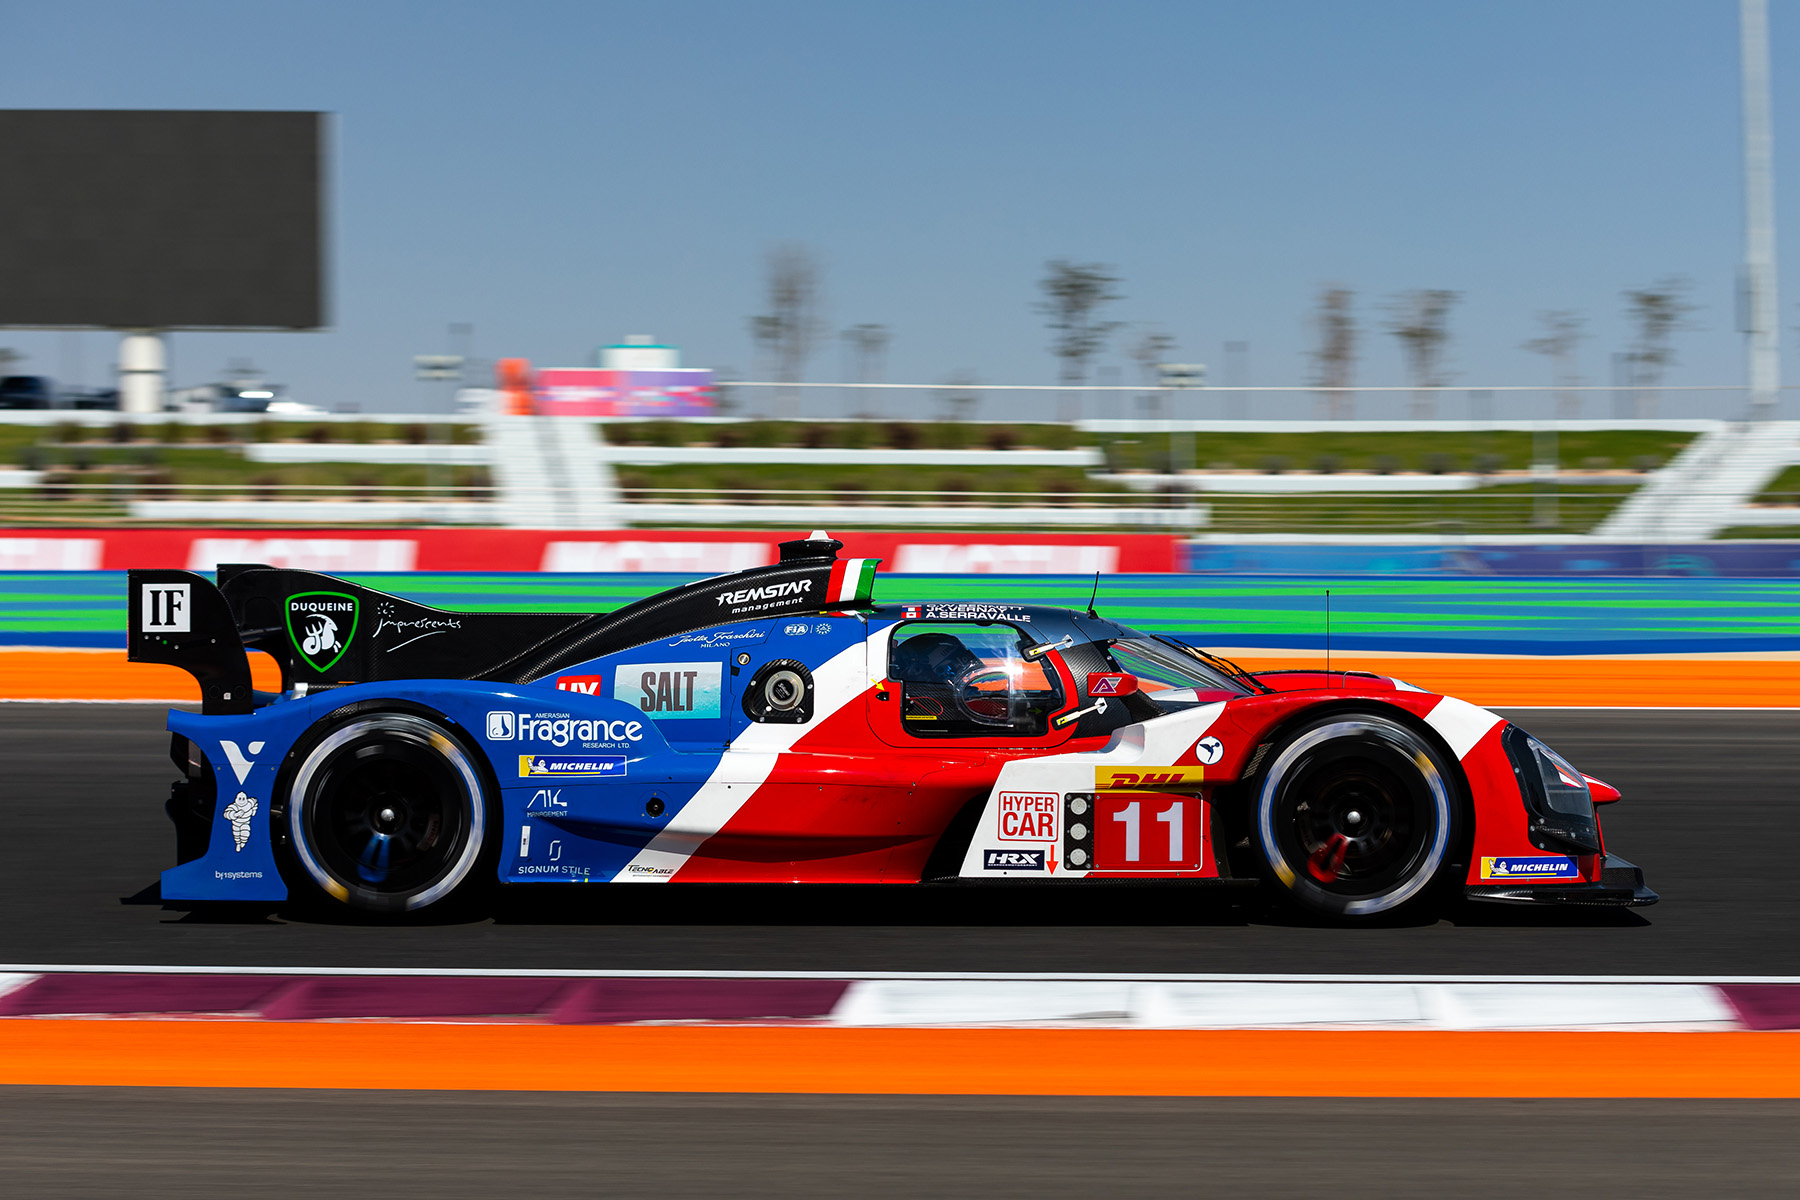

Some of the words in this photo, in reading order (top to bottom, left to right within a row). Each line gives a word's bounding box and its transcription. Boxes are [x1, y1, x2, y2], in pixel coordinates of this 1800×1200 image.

[716, 579, 812, 606] REMSTAR
[149, 590, 184, 626] IF
[291, 602, 353, 612] DUQUEINE
[731, 597, 803, 614] management
[925, 611, 1031, 622] A.SERRAVALLE
[785, 624, 807, 635] FIA
[640, 671, 697, 712] SALT
[518, 713, 643, 747] Fragrance
[549, 763, 614, 771] MICHELIN
[1107, 773, 1185, 789] DHL
[1003, 796, 1054, 813] HYPER
[526, 810, 568, 818] MANAGEMENT
[1002, 812, 1054, 837] CAR
[1112, 801, 1183, 862] 11
[987, 853, 1041, 864] HRX
[518, 865, 559, 874] SIGNUM
[561, 865, 591, 876] STILE
[1510, 863, 1569, 872] MICHELIN
